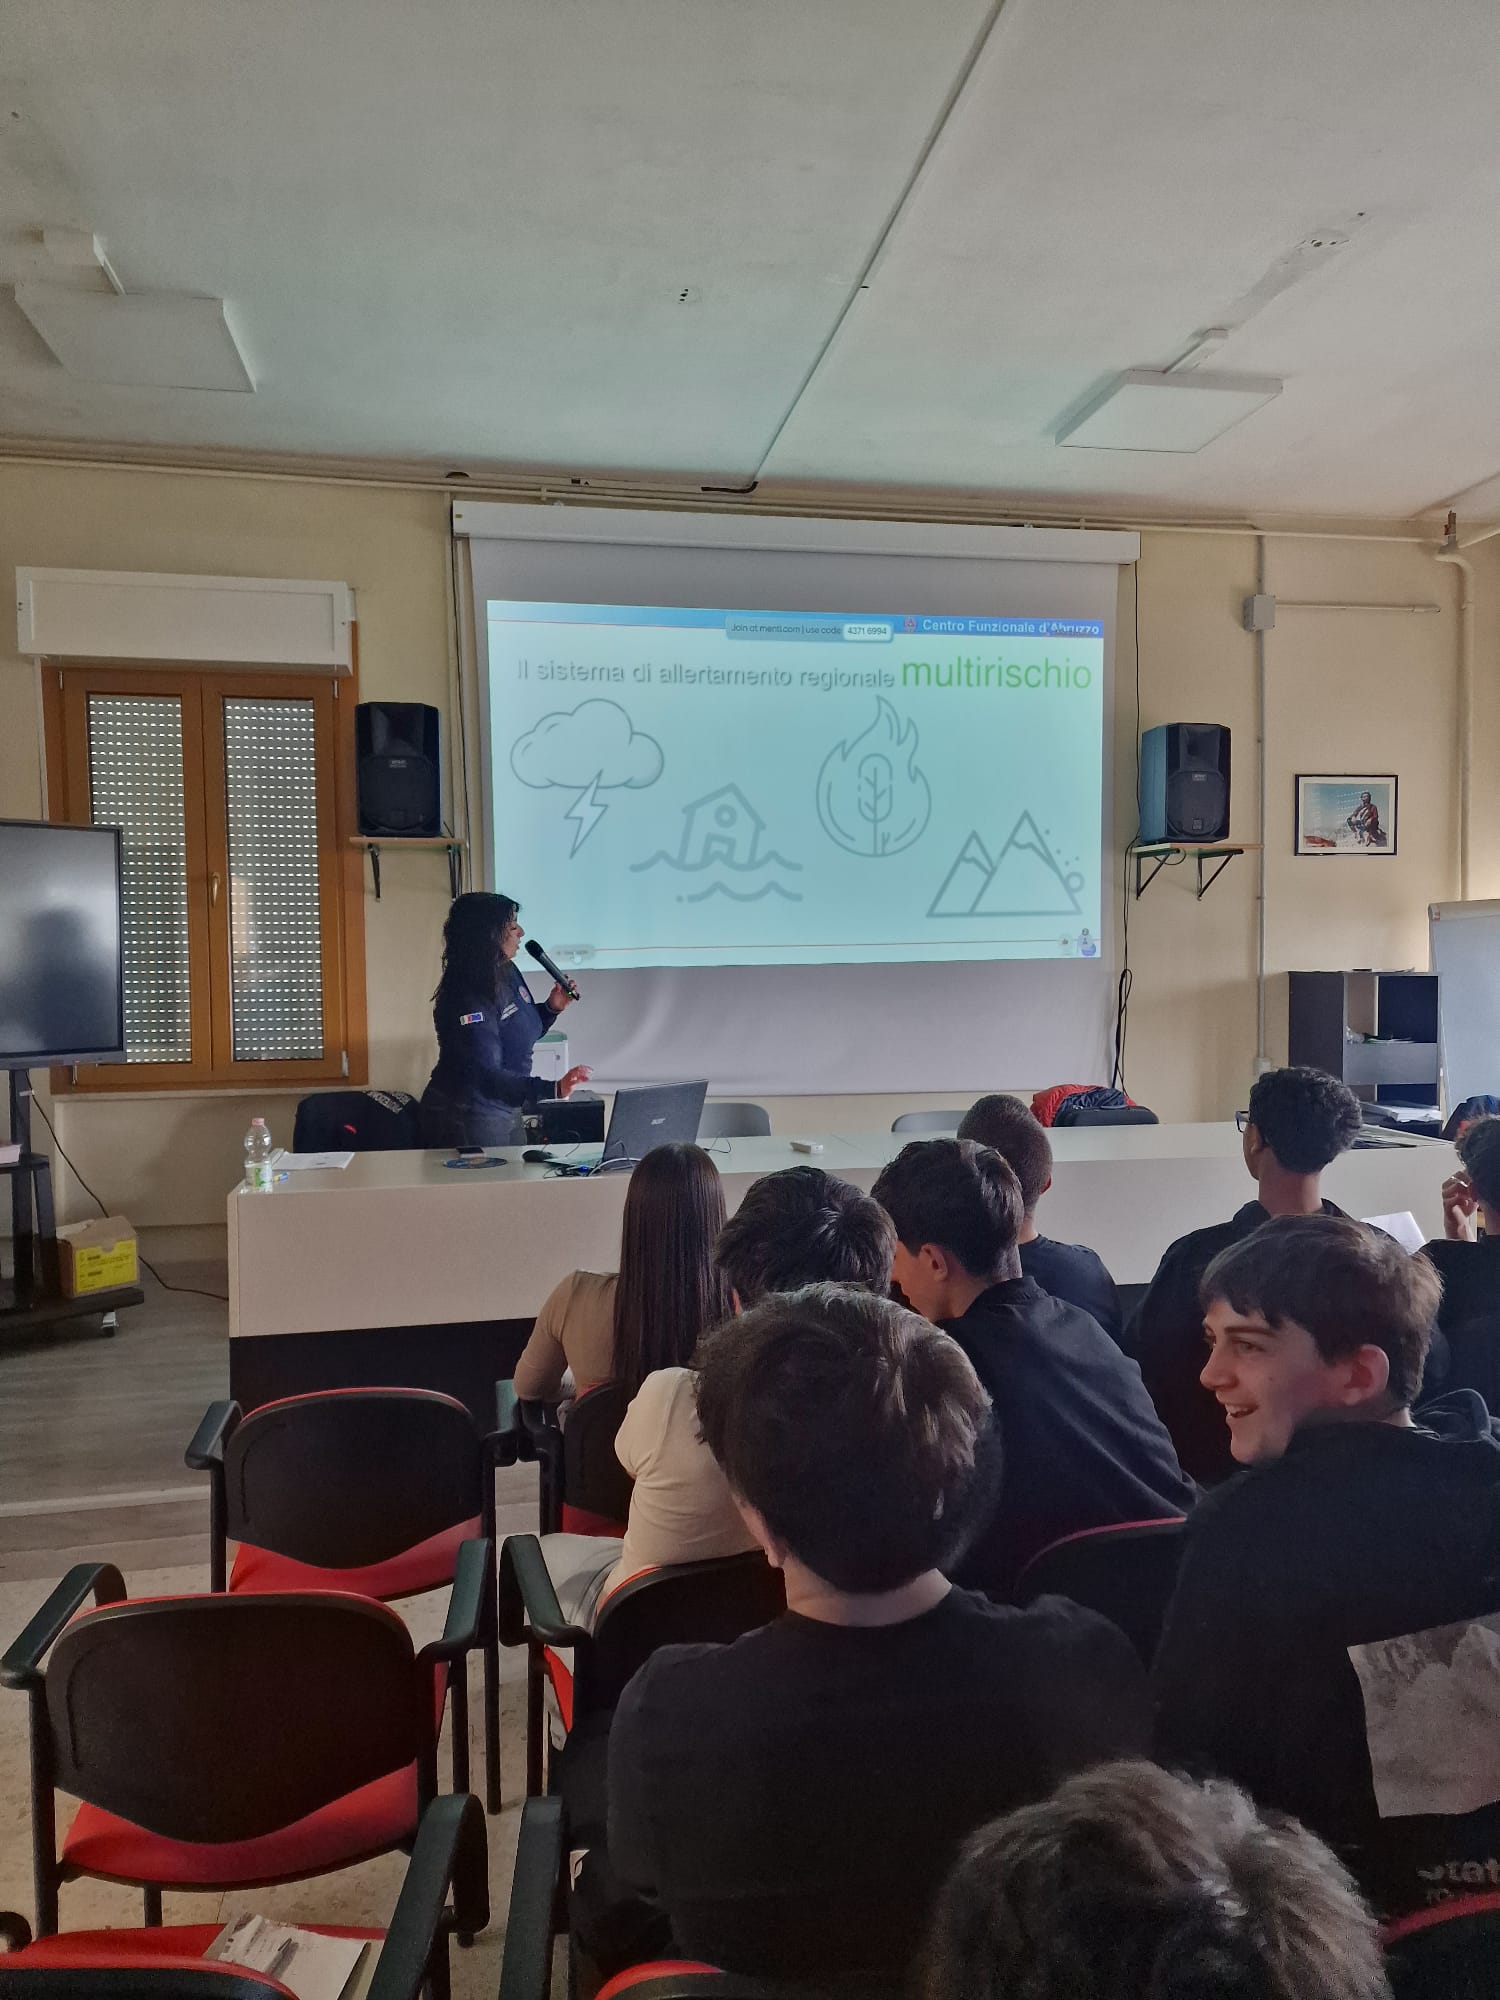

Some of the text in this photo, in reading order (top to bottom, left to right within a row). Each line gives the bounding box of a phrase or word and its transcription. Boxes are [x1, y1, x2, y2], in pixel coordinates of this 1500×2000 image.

[730, 623, 887, 636] Join at menti.com use code 4371 6994
[922, 618, 965, 632] Centro
[968, 620, 1036, 634] Funzionale
[517, 656, 1092, 693] Il sistema di allertamento regionale multirischio
